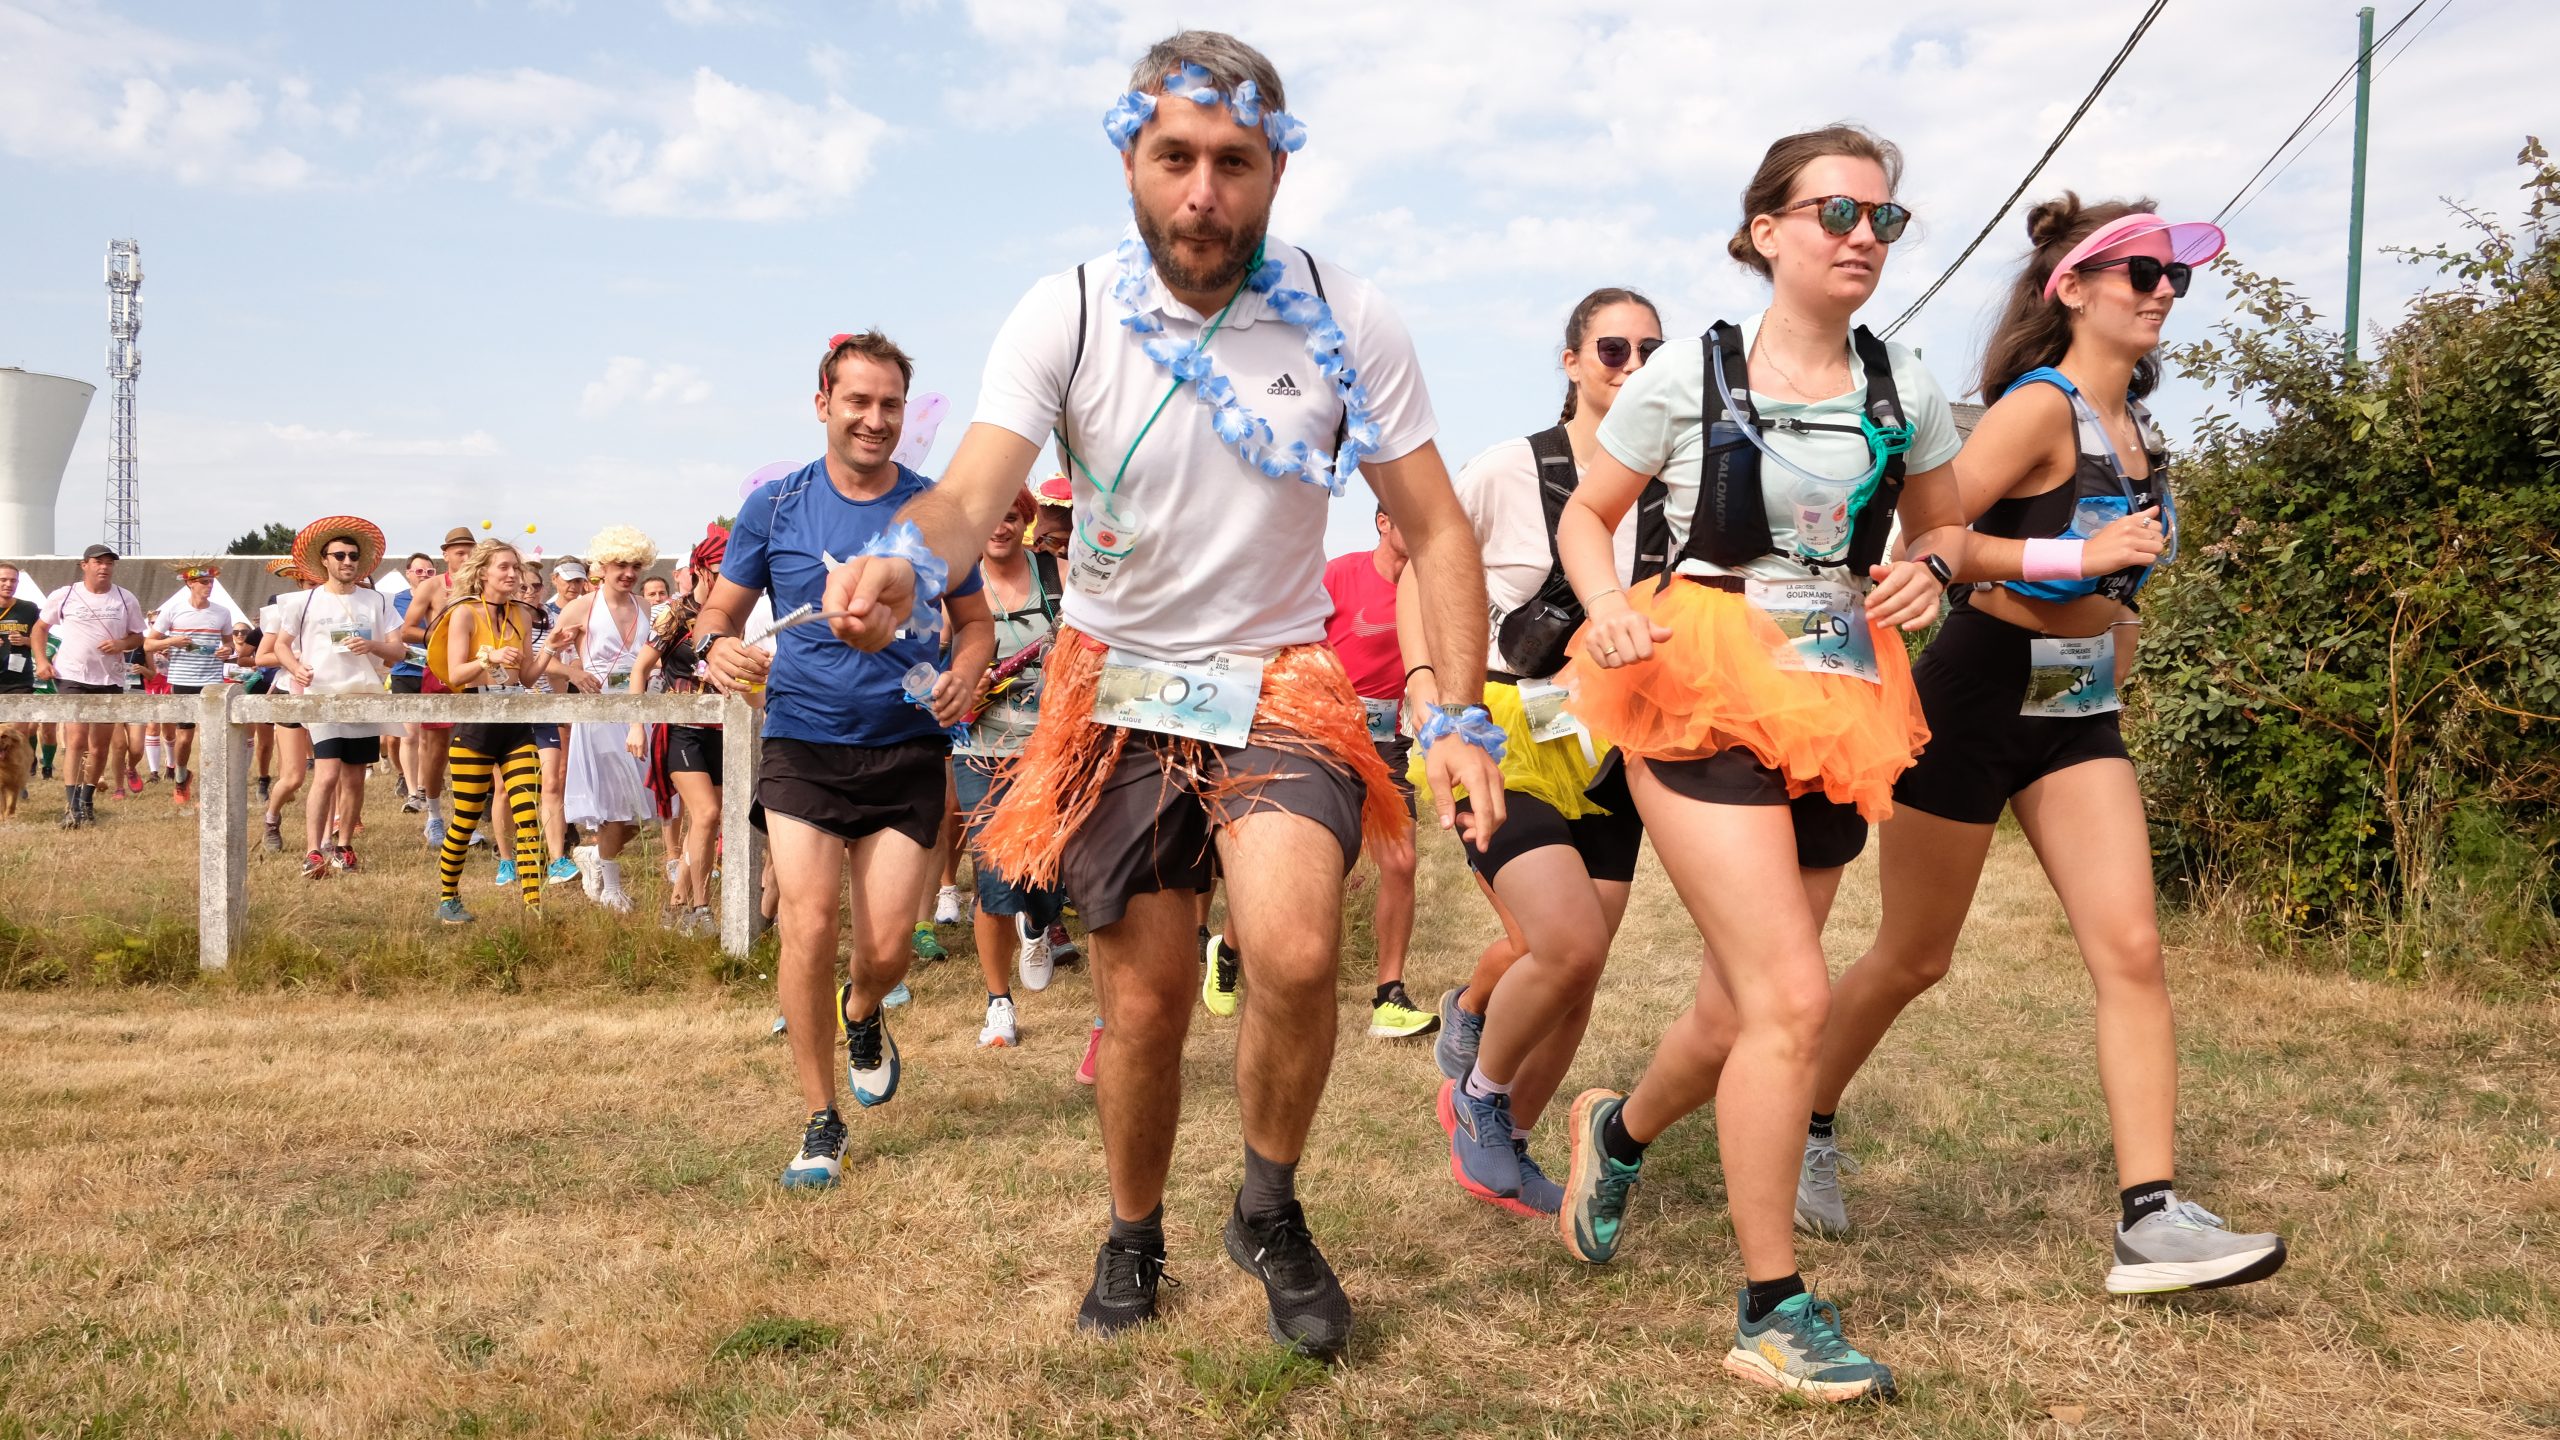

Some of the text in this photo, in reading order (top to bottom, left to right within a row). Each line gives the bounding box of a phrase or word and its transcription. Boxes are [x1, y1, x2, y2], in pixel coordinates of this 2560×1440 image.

[1267, 387, 1301, 397] adidas
[1715, 451, 1730, 532] SALOMON
[1786, 591, 1832, 600] GOURMANDE
[1802, 609, 1850, 650] 49
[1134, 671, 1219, 713] 102
[2068, 665, 2097, 696] 34
